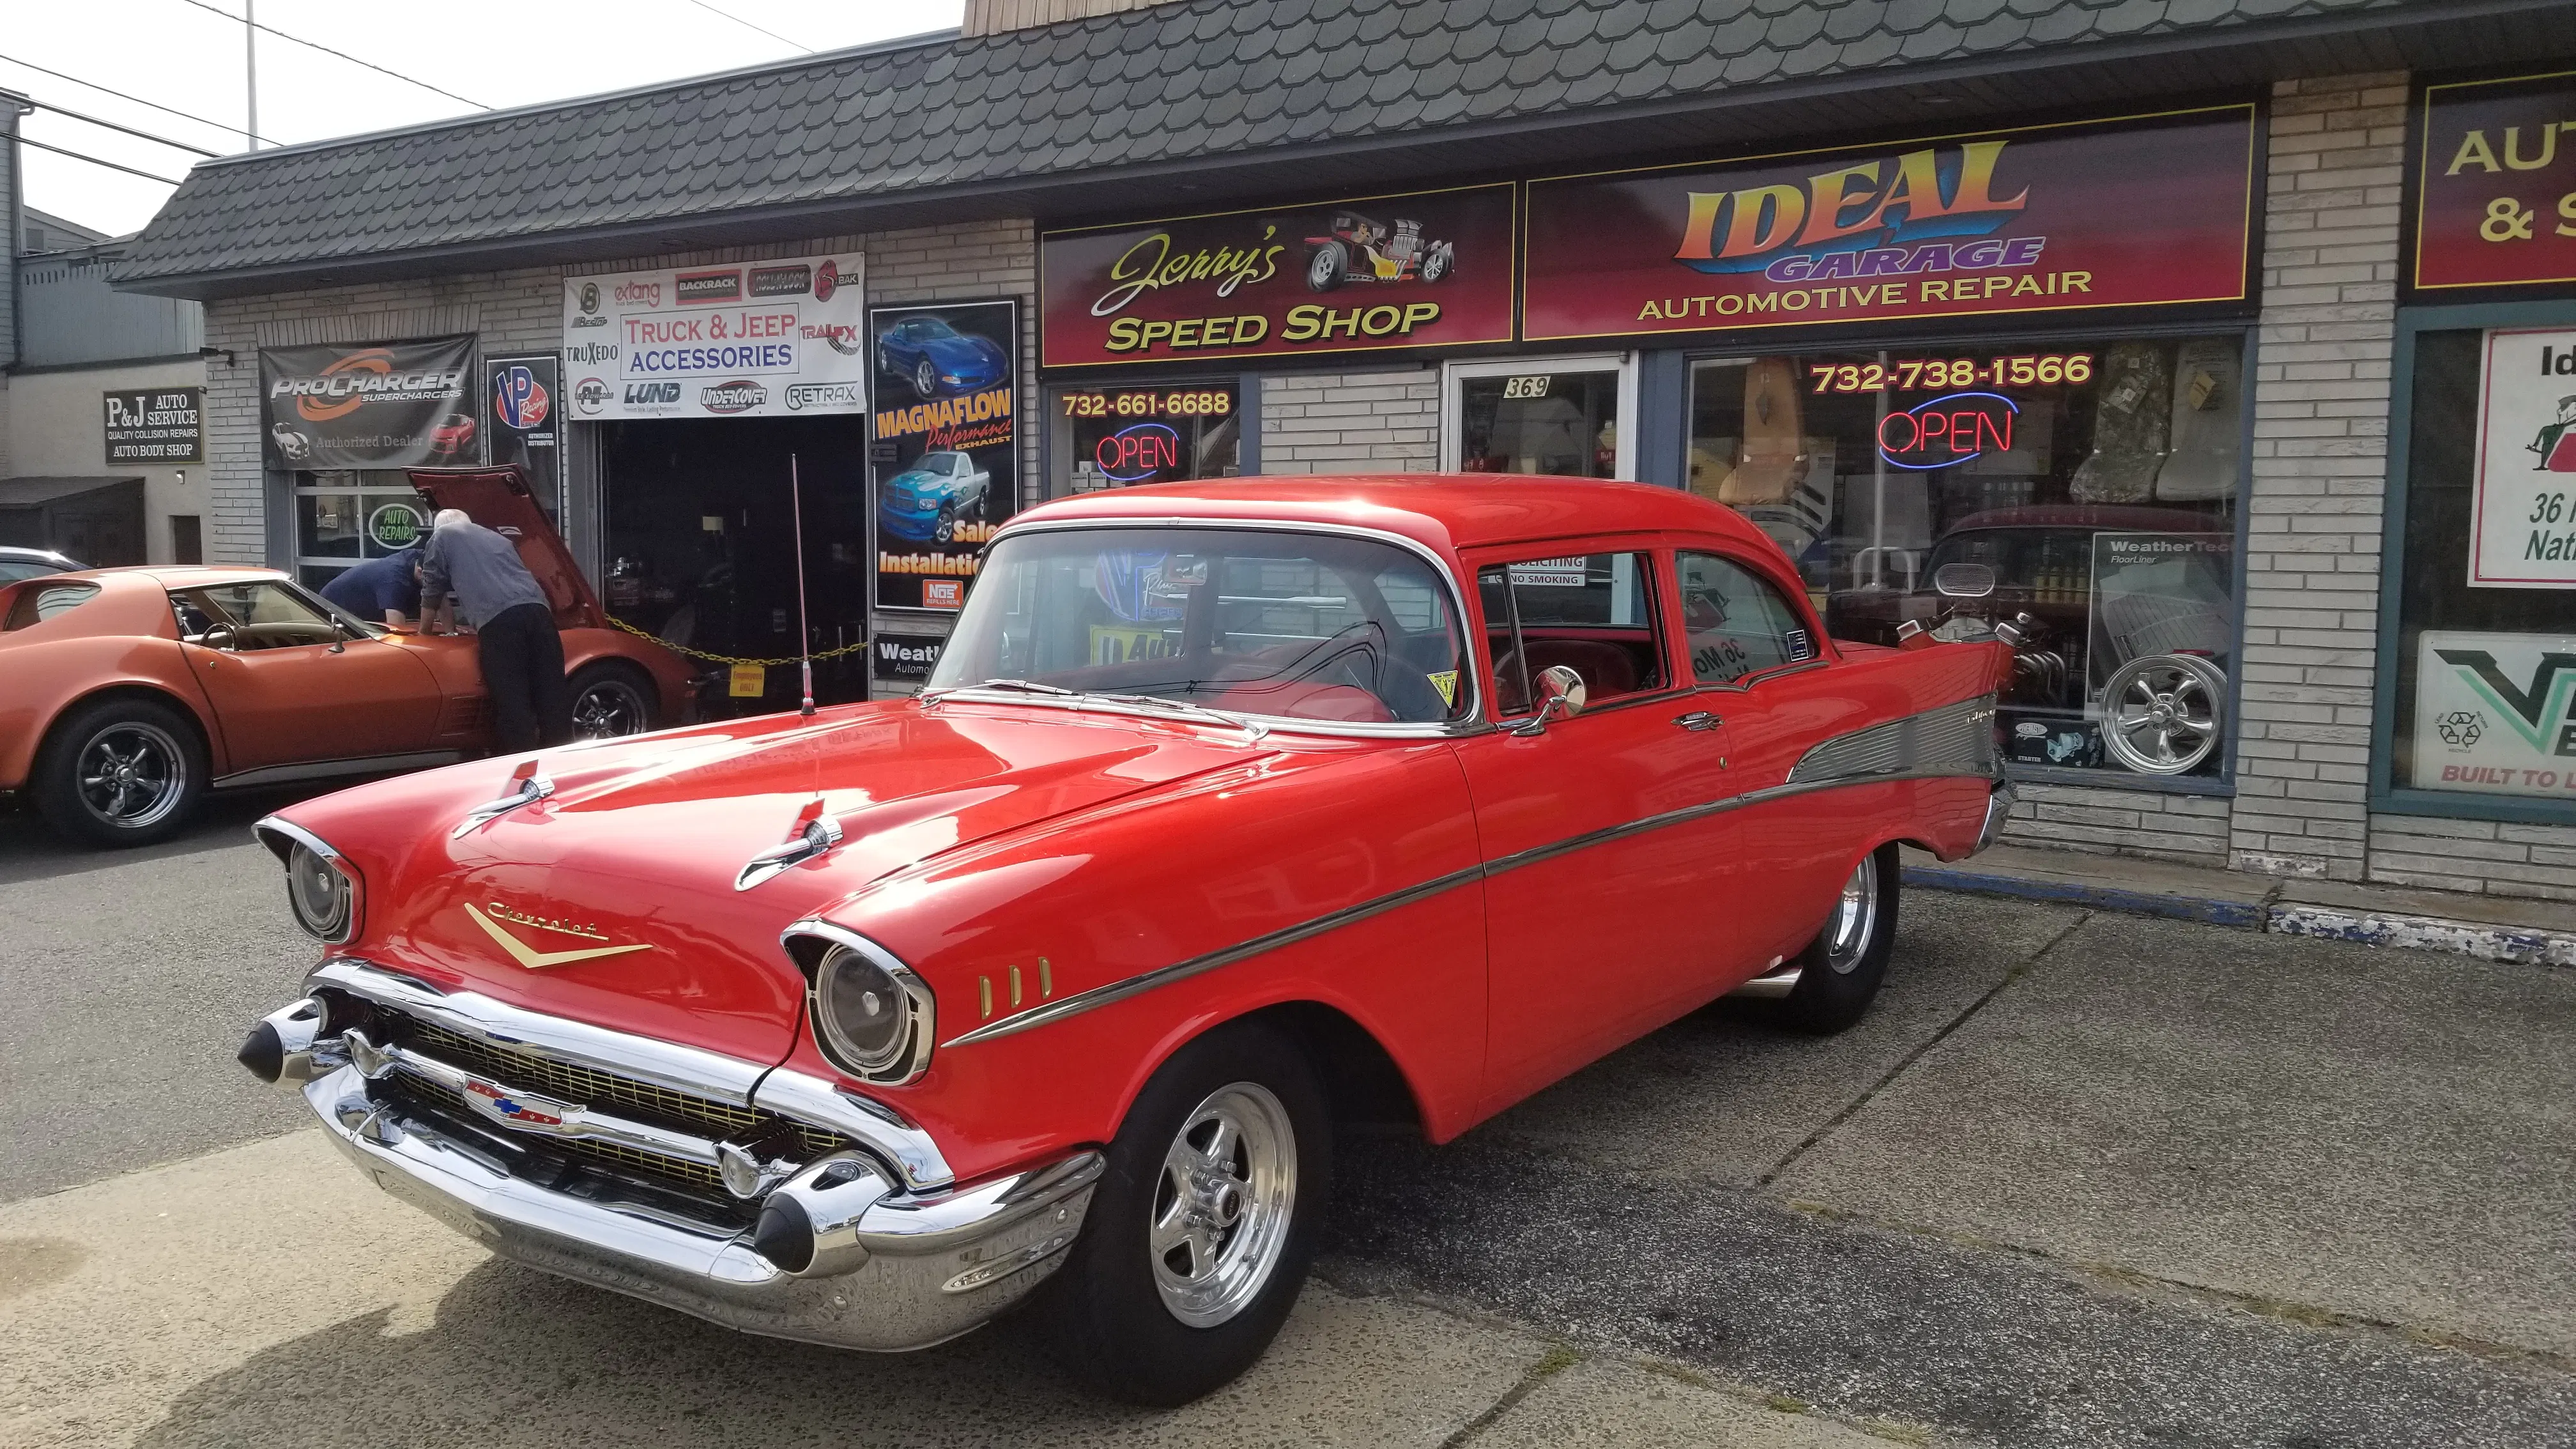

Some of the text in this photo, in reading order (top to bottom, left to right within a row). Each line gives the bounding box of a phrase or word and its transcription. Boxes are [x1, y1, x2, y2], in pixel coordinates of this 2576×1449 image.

[2444, 121, 2576, 176] AU
[1674, 140, 2030, 261] IDEAL
[2480, 197, 2534, 241] &
[1091, 226, 1285, 316] Jerry's
[1765, 236, 2046, 283] GARAGE
[615, 279, 661, 308] extang
[679, 279, 736, 290] BACKRACK
[1637, 271, 2093, 321] AUTOMOTIVE REPAIR
[625, 313, 796, 344] TRUCK & JEEP
[1104, 302, 1443, 351] SPEED SHOP
[566, 342, 618, 365] TRUXEDO
[629, 344, 792, 372] ACCESSORIES
[2542, 345, 2576, 375] Id
[1812, 355, 2091, 393] 732-738-1566
[362, 389, 463, 402] SUPERCHARGERS
[496, 366, 533, 428] VP
[624, 383, 681, 404] LUND
[702, 387, 767, 405] UNDERCOVER
[790, 385, 856, 402] RETRAX
[1506, 377, 1547, 397] 369
[107, 397, 145, 427] P&J
[156, 394, 187, 409] AUTO
[1062, 393, 1230, 416] 732-661-6688
[148, 410, 197, 425] SERVICE
[877, 388, 1011, 439] MAGNAFLOW
[108, 429, 197, 440] QUALITY COLLISION REPAIRS
[316, 435, 423, 448] Authorized Dealer
[925, 418, 1012, 454] Performance
[955, 435, 1012, 450] EXHAUST
[1878, 411, 2012, 453] OPEN
[114, 444, 192, 457] AUTO BODY SHOP
[1097, 436, 1176, 469] OPEN
[384, 510, 410, 524] AUTO
[2529, 493, 2564, 523] 36
[379, 526, 416, 540] REPAIRS
[2110, 541, 2230, 552] WeatherTec
[1510, 557, 1583, 567] LICITING
[2111, 555, 2157, 564] FloorLiner
[929, 584, 958, 599] NOS
[1528, 576, 1578, 584] SMOKING
[895, 663, 930, 674] Automo
[2441, 765, 2517, 785] BUILT
[2523, 769, 2557, 788] TO
[487, 901, 599, 938] Chevrolet
